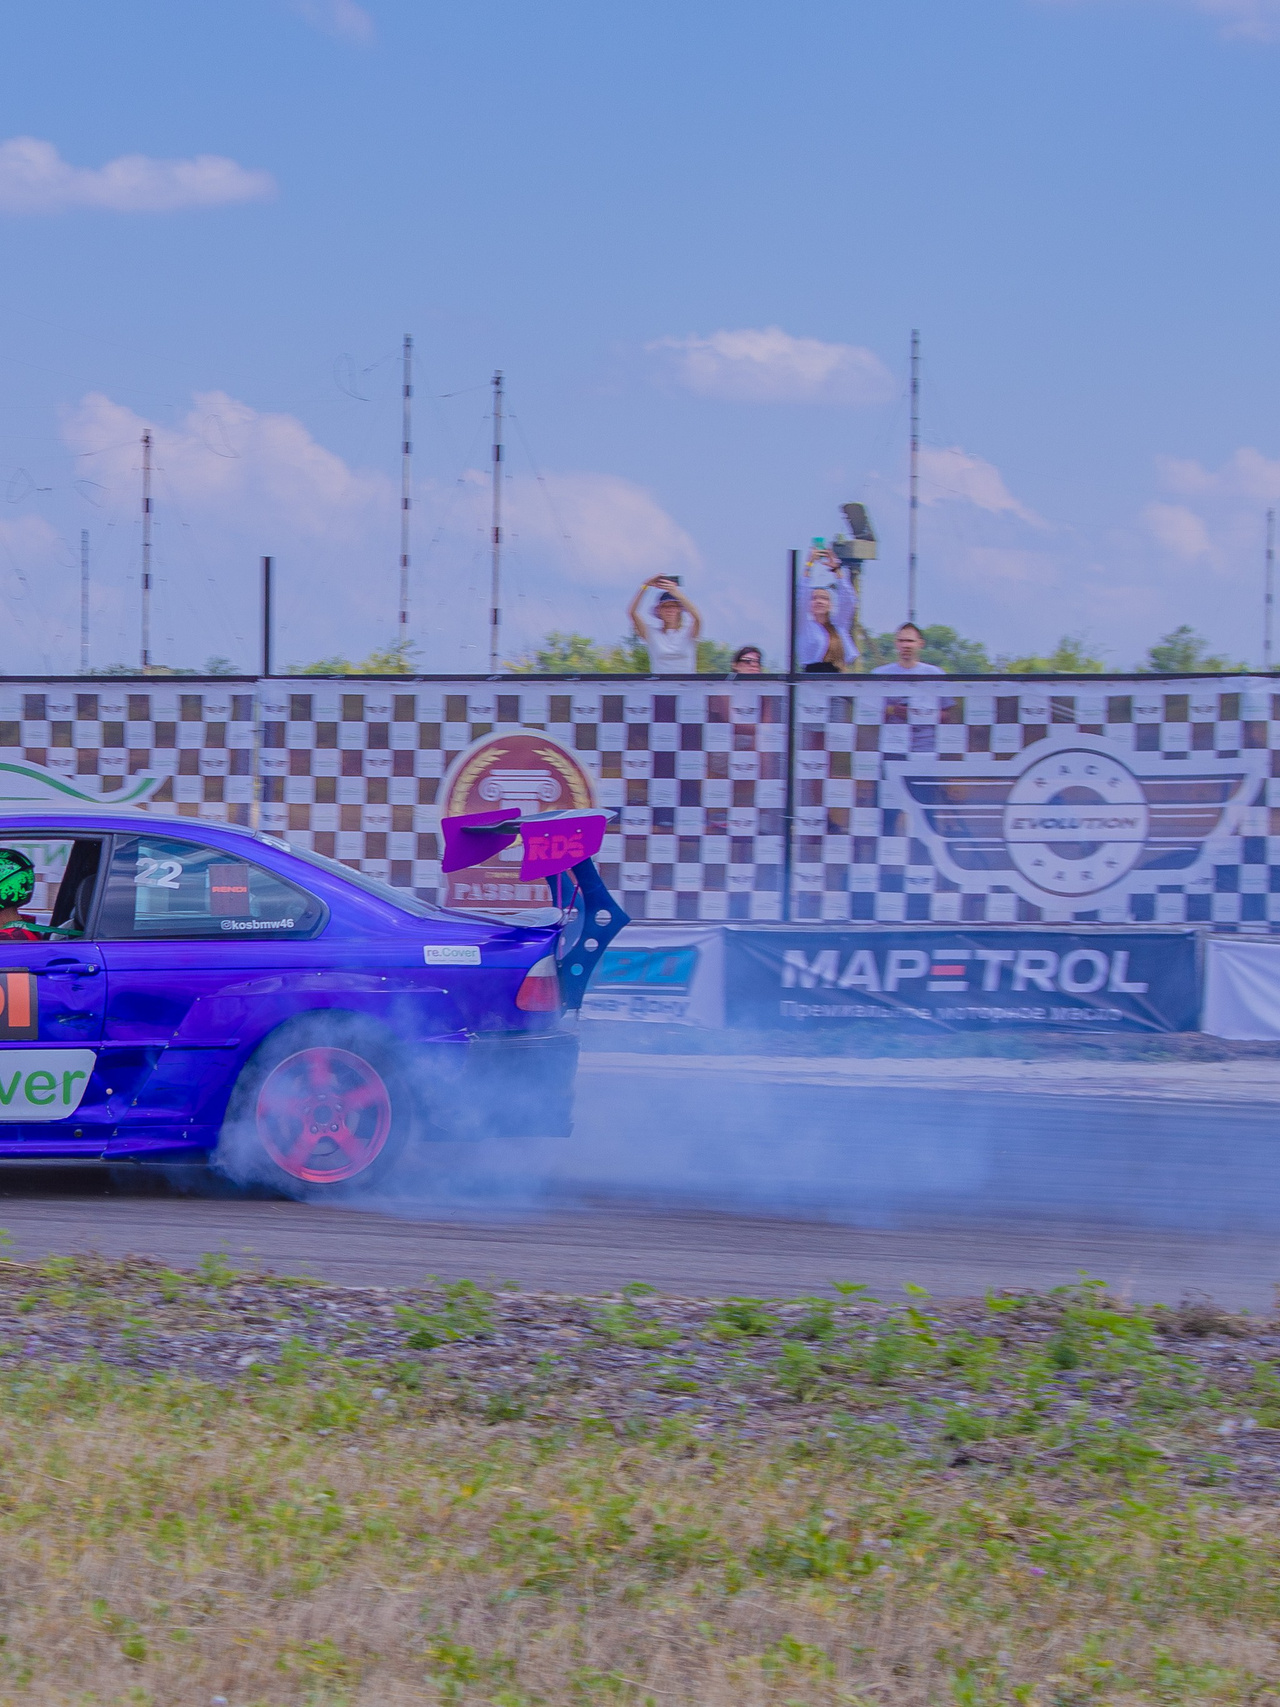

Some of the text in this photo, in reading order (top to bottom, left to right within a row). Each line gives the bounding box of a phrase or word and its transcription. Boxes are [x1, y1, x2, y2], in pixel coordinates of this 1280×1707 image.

[527, 833, 585, 861] RDS
[133, 857, 183, 890] 22
[220, 918, 295, 931] @kosbmw46
[426, 947, 478, 957] re.Cover
[781, 949, 1150, 993] MAPETROL
